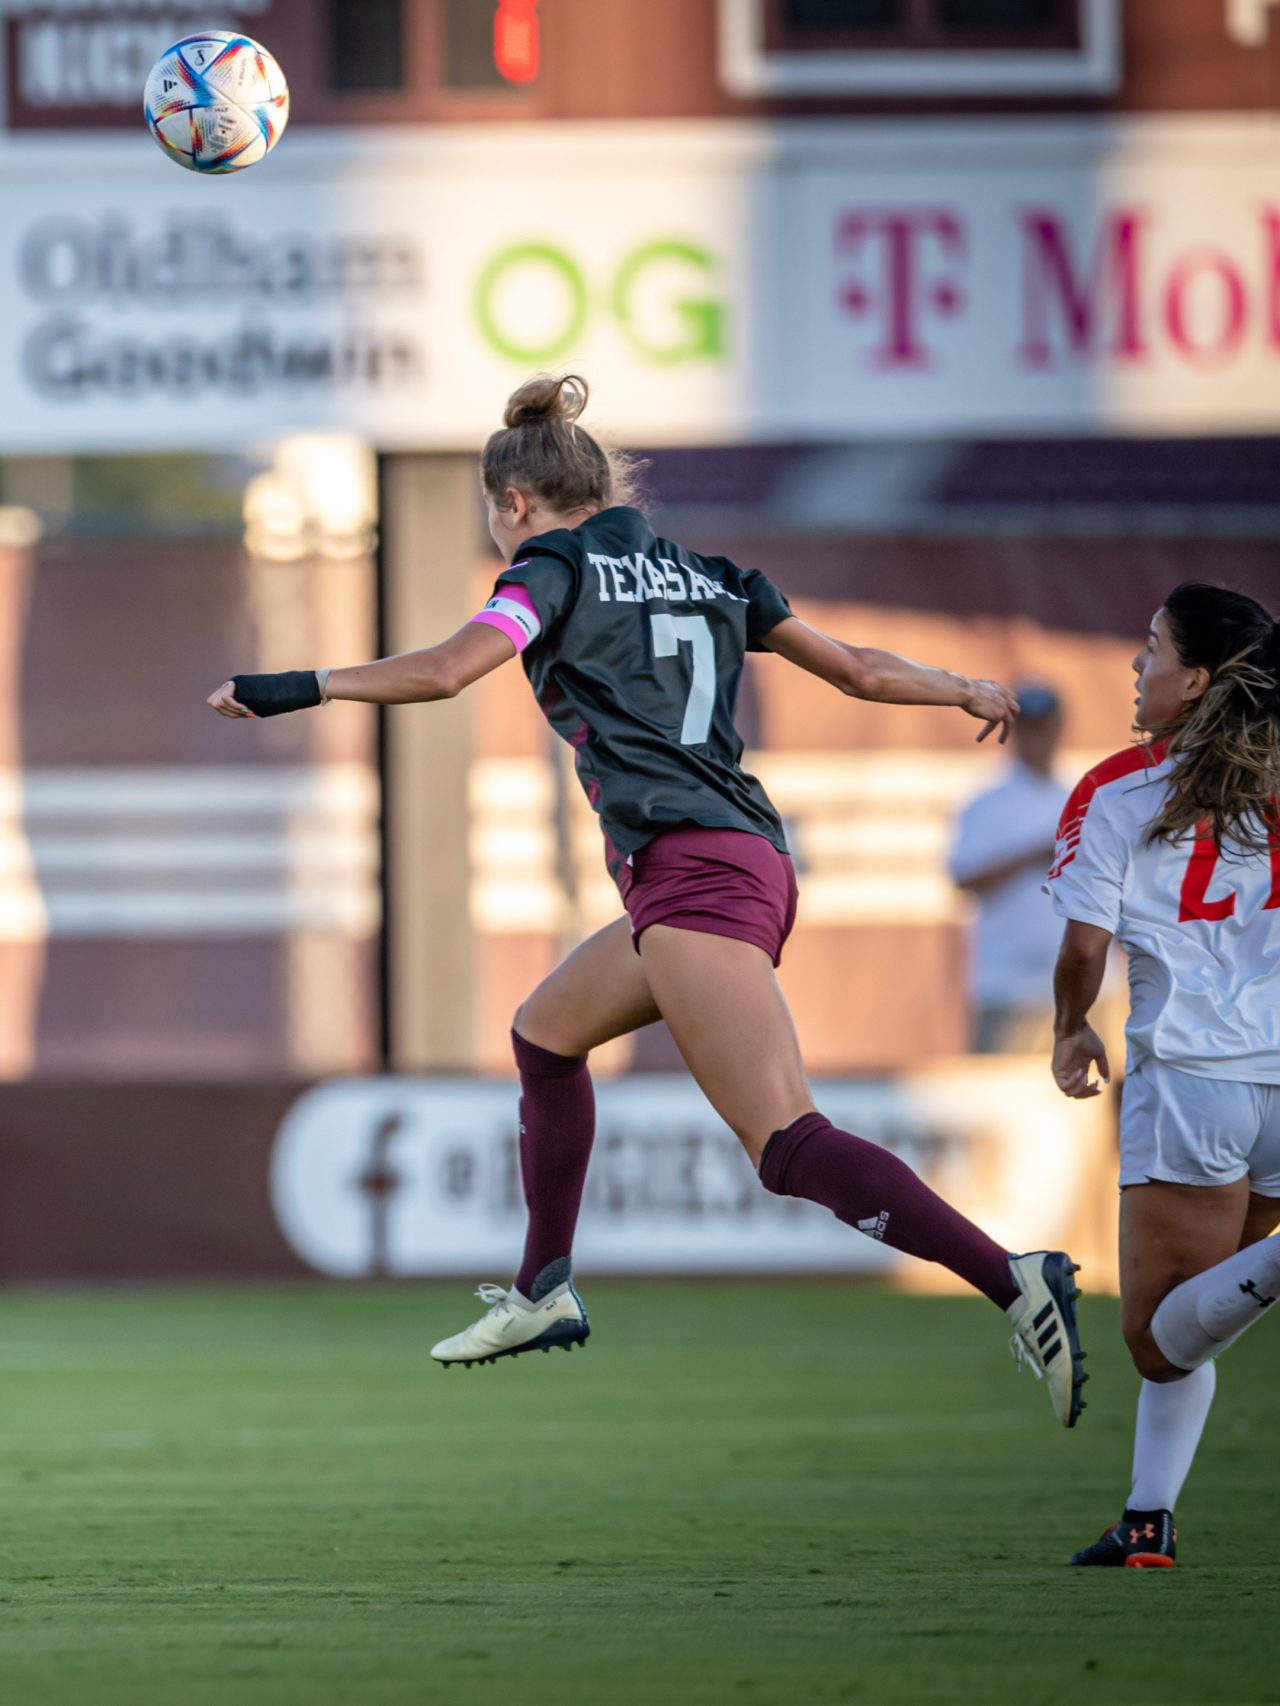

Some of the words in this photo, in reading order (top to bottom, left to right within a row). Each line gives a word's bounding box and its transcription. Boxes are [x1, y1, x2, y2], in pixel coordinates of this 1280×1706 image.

[19, 207, 424, 304] Oldham
[475, 242, 727, 364] OG
[1015, 205, 1280, 374] Mo
[19, 311, 424, 402] Goodwin
[587, 552, 687, 603] TEXAS
[650, 613, 716, 745] 7
